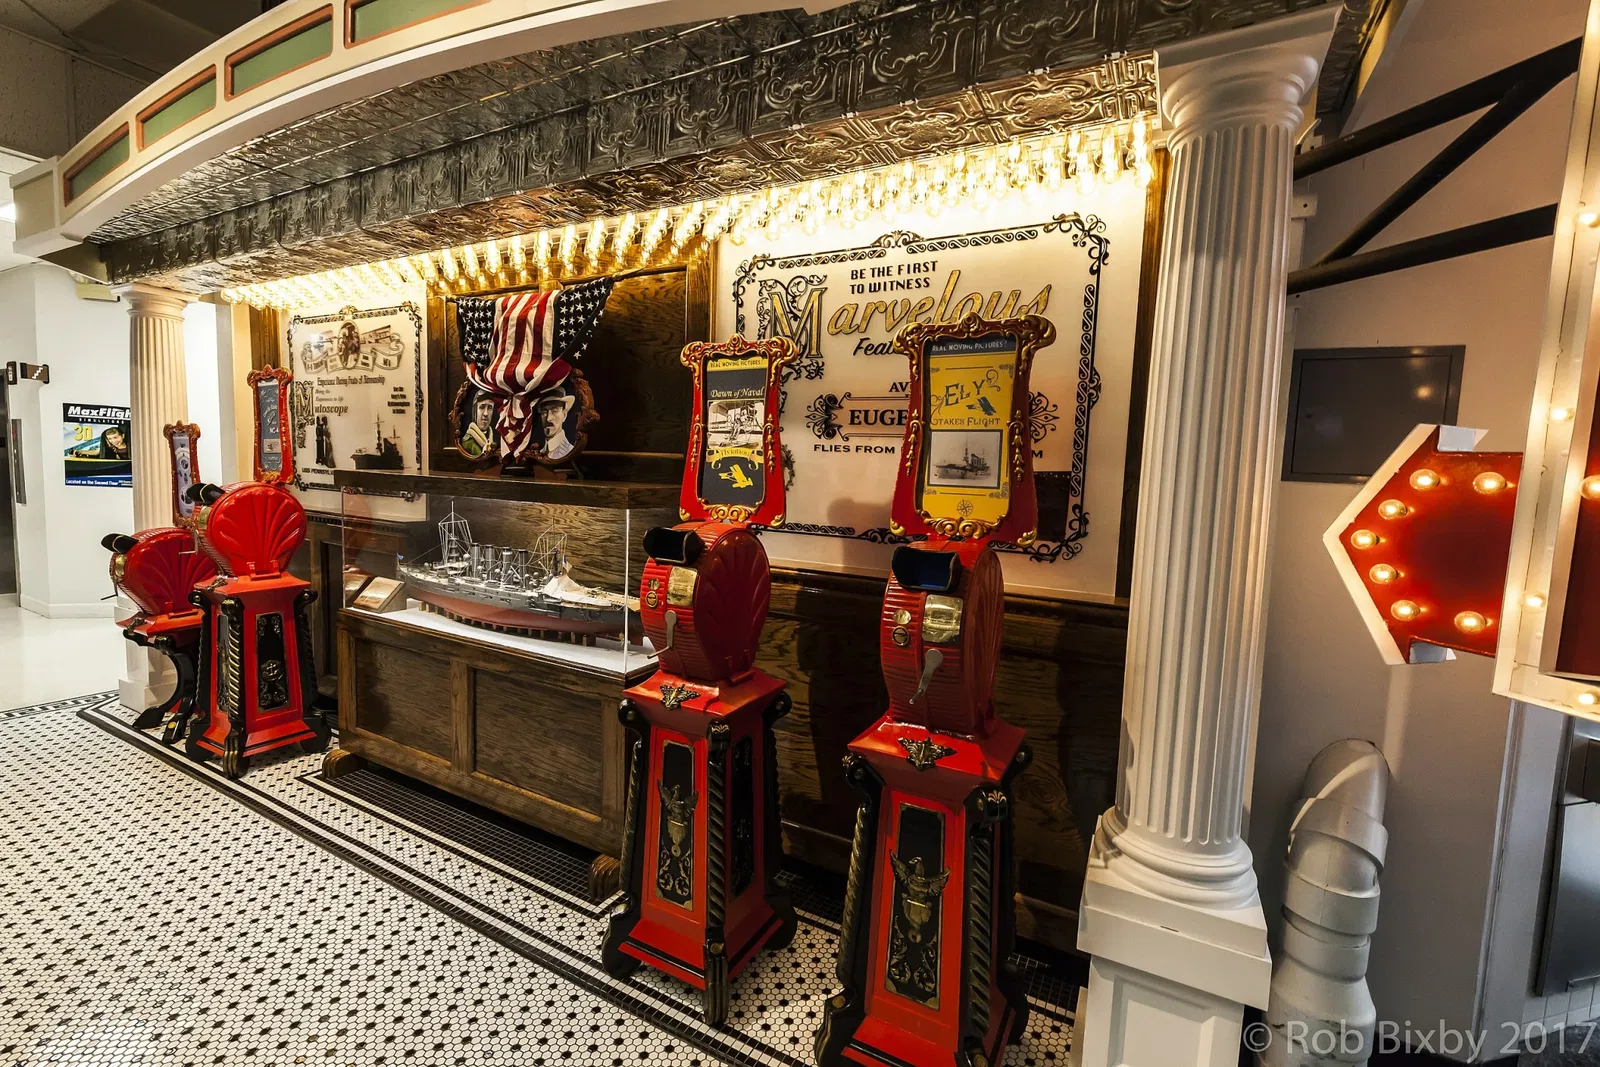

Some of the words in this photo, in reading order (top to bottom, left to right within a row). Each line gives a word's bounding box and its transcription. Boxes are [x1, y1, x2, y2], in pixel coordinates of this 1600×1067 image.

[850, 268, 866, 280] BE
[870, 265, 893, 278] THE
[897, 260, 938, 276] FIRST
[849, 283, 865, 295] TO
[868, 276, 931, 293] WITNESS
[767, 269, 1052, 359] Marvelous
[852, 336, 896, 356] Feat
[710, 389, 733, 398] Dawn
[733, 388, 741, 399] of
[742, 386, 765, 397] Naval
[944, 379, 986, 407] ELY
[68, 406, 131, 418] MaxFligh
[848, 409, 908, 426] EUGE
[938, 418, 965, 426] TAKES
[74, 425, 92, 441] 3D
[813, 443, 851, 453] FLIES
[855, 445, 895, 454] FROM
